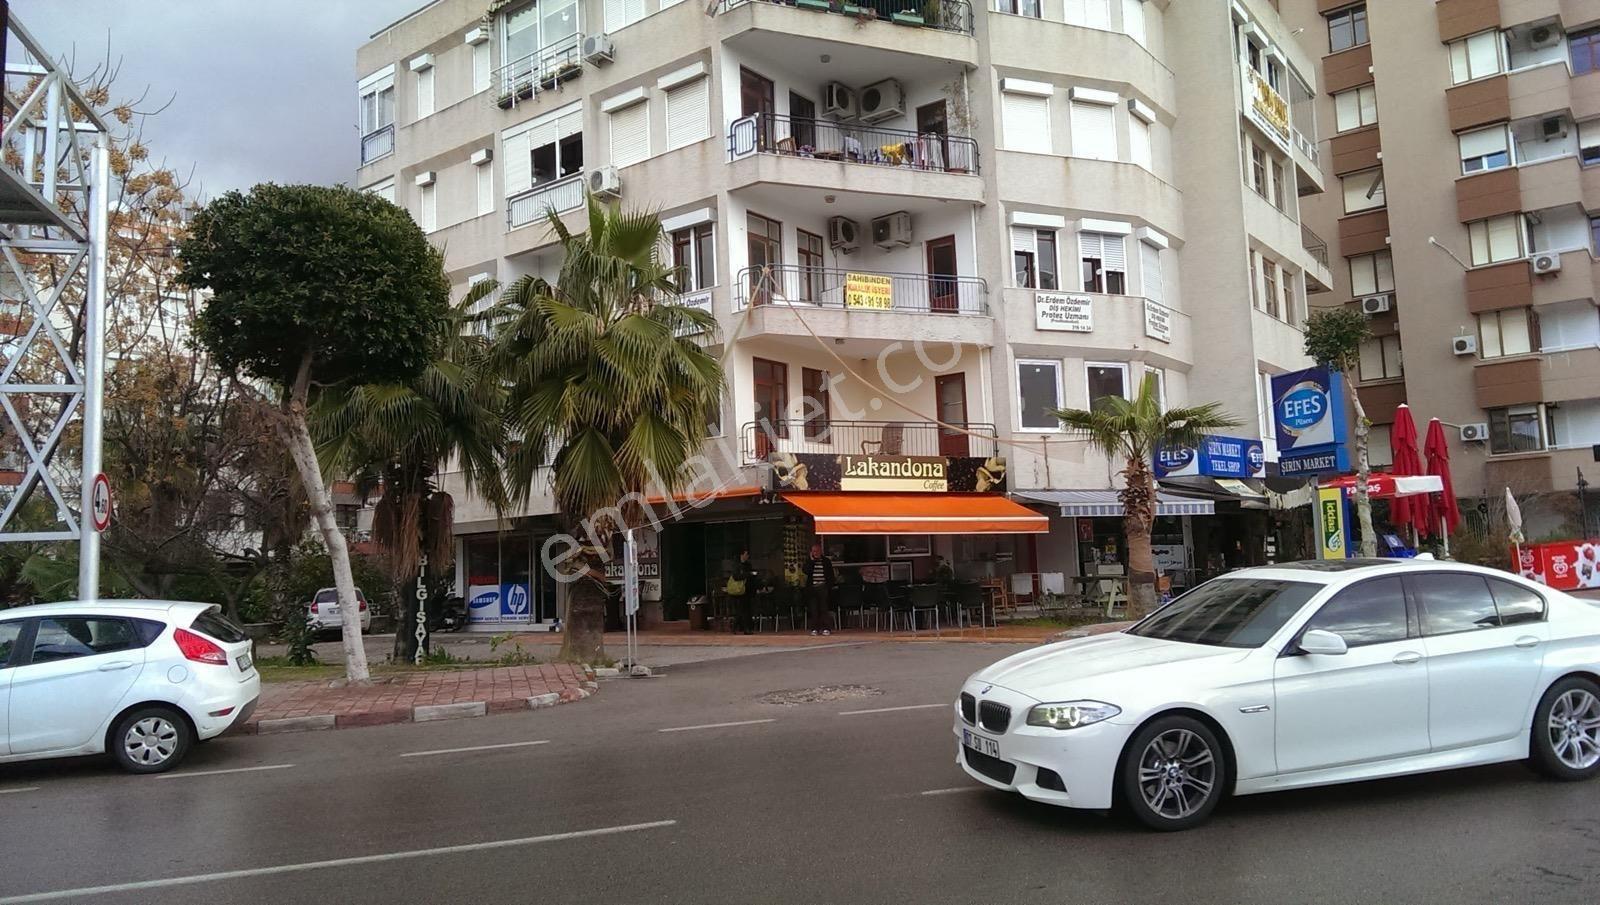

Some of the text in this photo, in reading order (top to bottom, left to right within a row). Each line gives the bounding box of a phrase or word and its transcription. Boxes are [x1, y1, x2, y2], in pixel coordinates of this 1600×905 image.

[1284, 395, 1321, 418] EFES
[1295, 418, 1313, 426] Pilsen
[1222, 443, 1241, 458] MARKET
[845, 456, 944, 477] Lakandona
[1302, 456, 1336, 471] MARKET
[923, 480, 945, 492] Coffee
